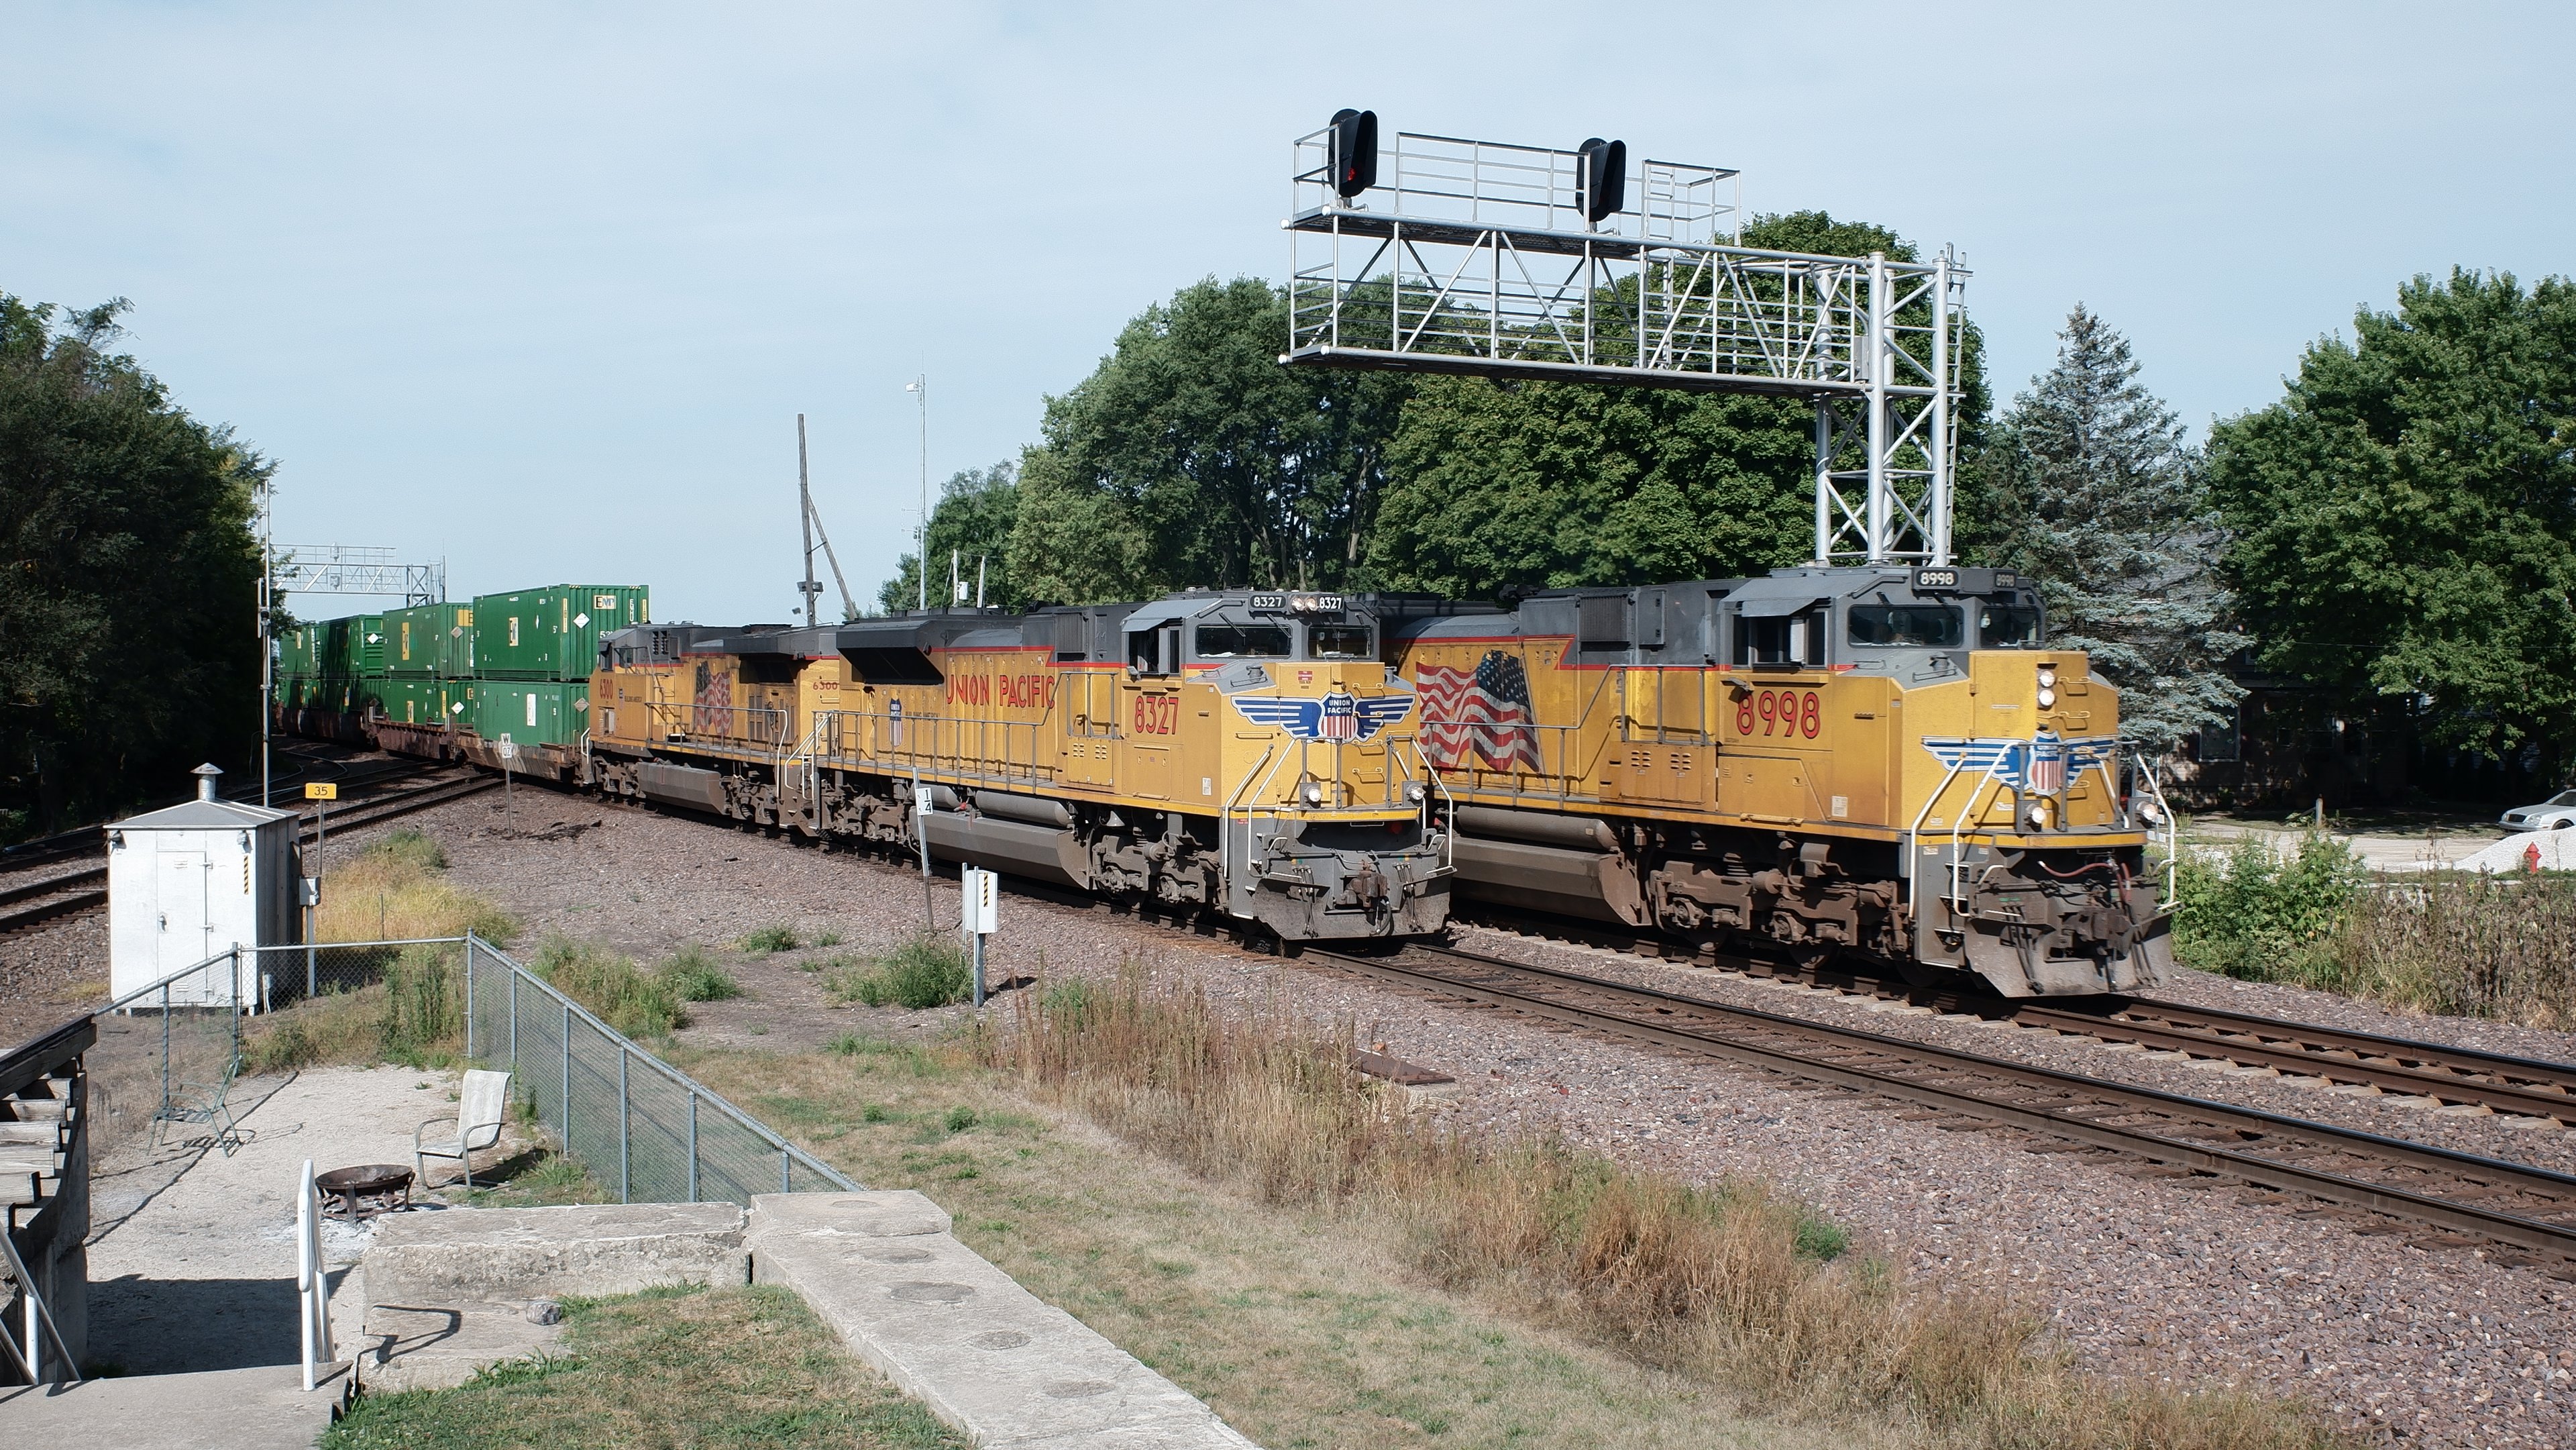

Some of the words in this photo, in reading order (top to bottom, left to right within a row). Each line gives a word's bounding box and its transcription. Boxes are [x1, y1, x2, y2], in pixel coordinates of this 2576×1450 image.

[1921, 572, 1954, 585] 8998
[1996, 574, 2015, 587] 8998
[596, 597, 614, 608] EMP
[1254, 597, 1282, 607] 8327
[1319, 597, 1342, 609] 8327
[600, 678, 614, 700] 6300
[812, 681, 838, 690] 6300
[946, 674, 989, 707] UNION
[999, 674, 1055, 709] PACIFIC
[1134, 695, 1179, 735] 8327
[1737, 690, 1821, 739] 8998
[502, 735, 510, 744] W
[314, 786, 328, 796] 35
